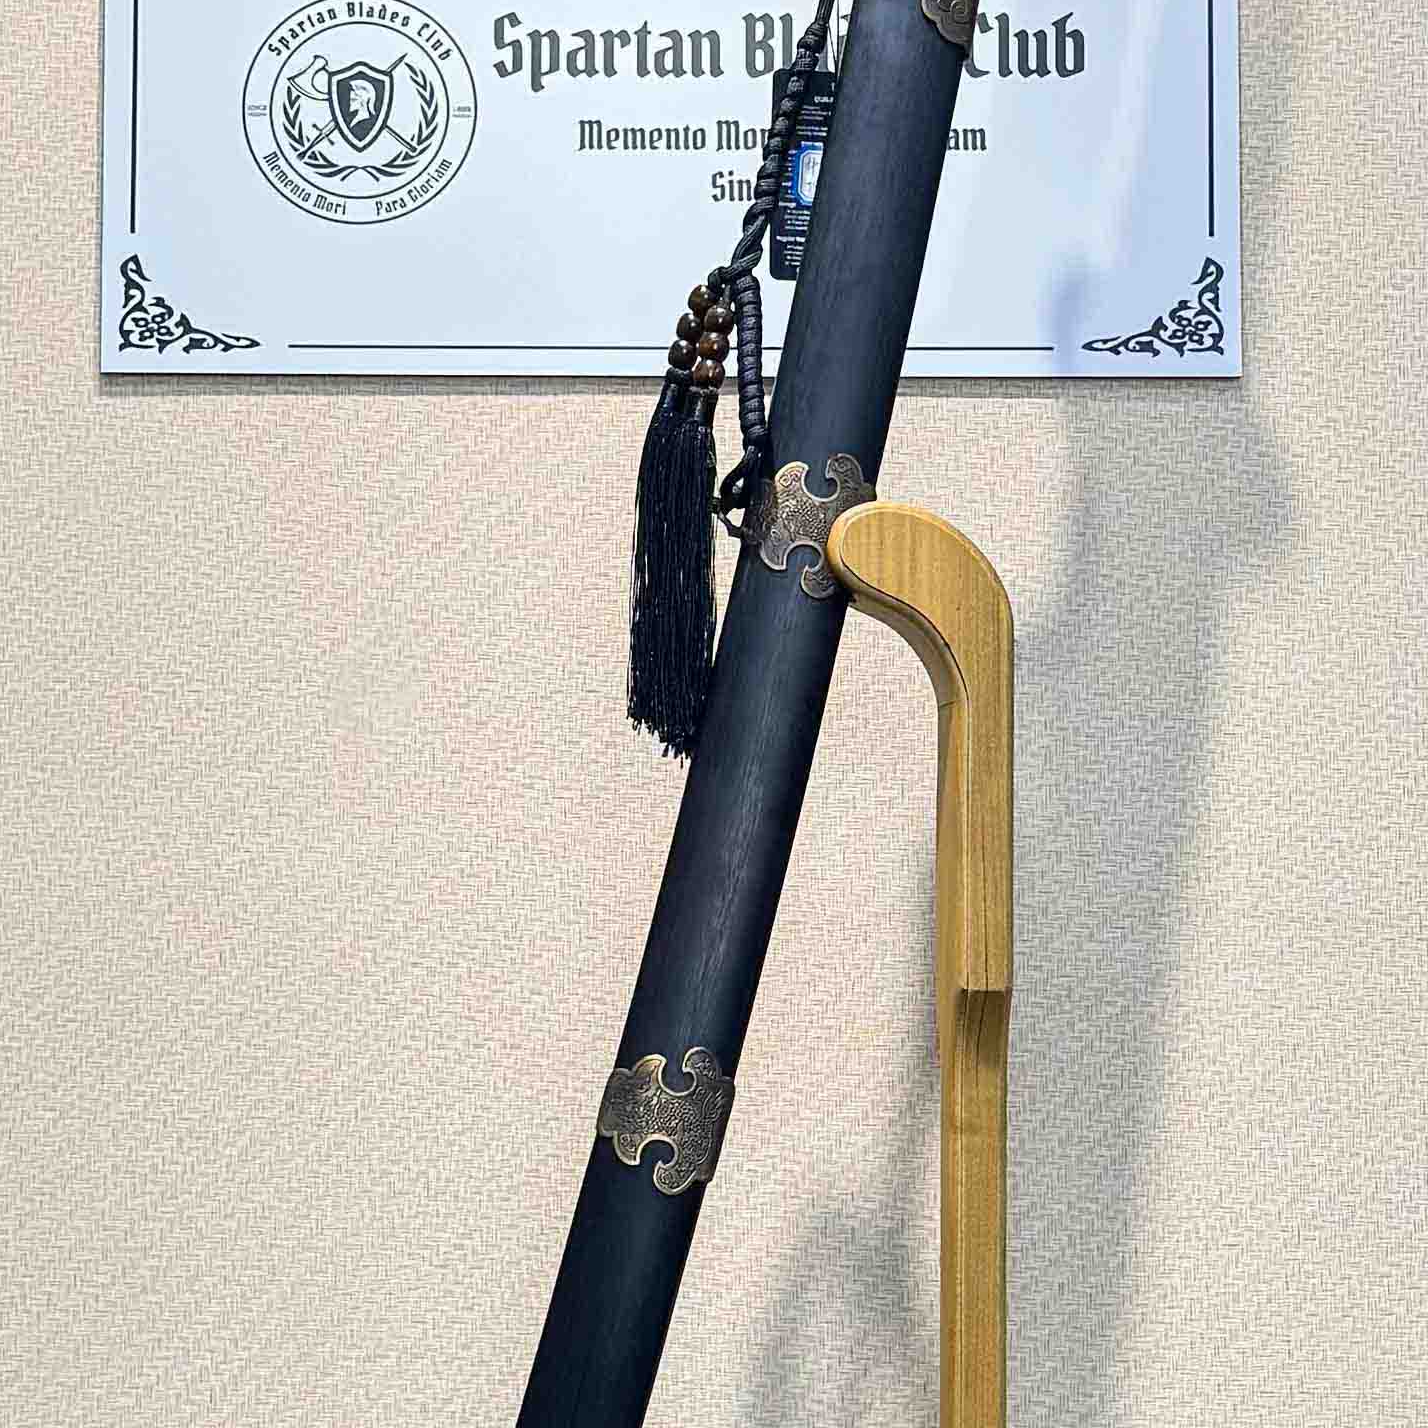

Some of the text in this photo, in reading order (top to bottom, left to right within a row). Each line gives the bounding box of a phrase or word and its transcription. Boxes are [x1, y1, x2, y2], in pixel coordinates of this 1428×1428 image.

[267, 1, 453, 61] Spartan Blades Club
[492, 11, 724, 92] Spartan
[963, 11, 1085, 79] Club
[578, 119, 706, 151] Memento
[716, 119, 770, 152] Mor
[262, 150, 347, 216] Memento Mori
[375, 157, 453, 216] Para Gloriam
